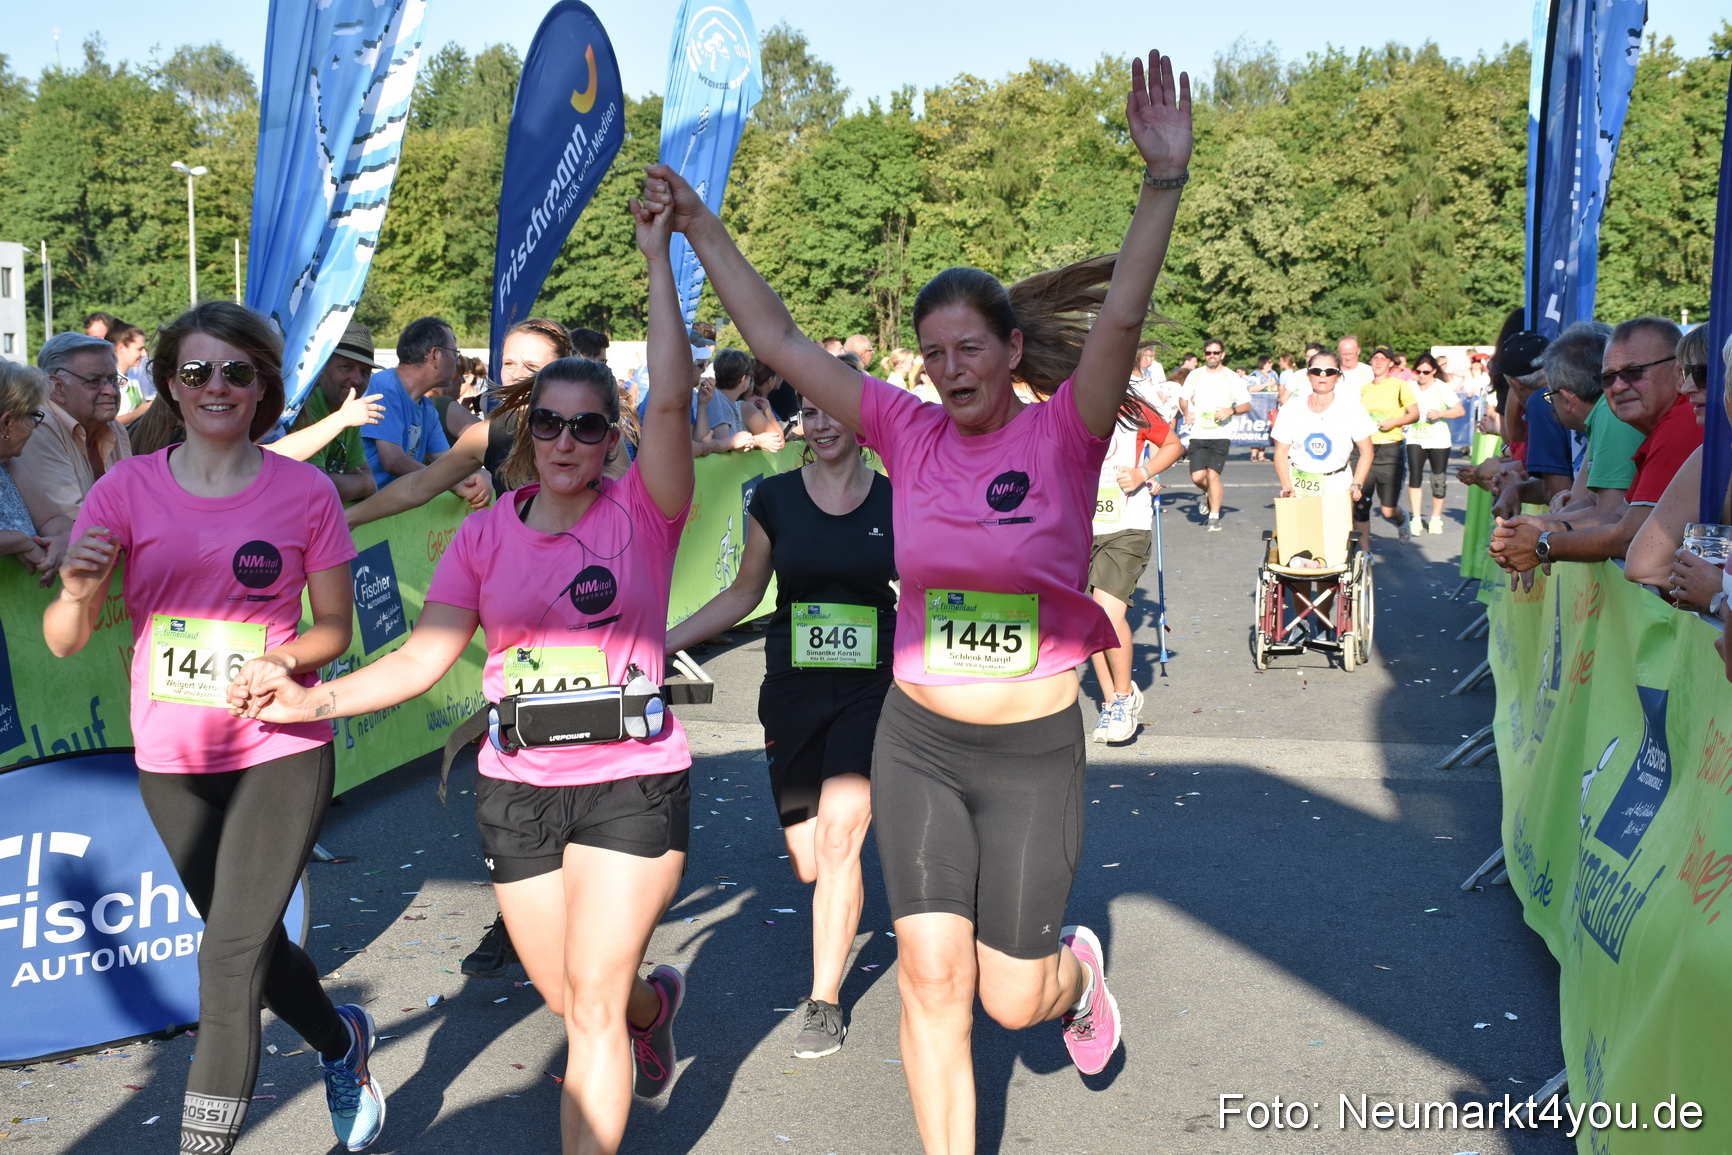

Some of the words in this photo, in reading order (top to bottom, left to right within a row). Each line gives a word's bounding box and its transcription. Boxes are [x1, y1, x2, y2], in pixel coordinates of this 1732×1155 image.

[558, 178, 580, 224] Druck
[592, 102, 617, 152] Medien
[1294, 477, 1320, 492] 2025
[1096, 500, 1114, 513] 58
[360, 575, 391, 602] Fischer
[367, 591, 392, 610] AUTOMOBILE
[940, 602, 977, 612] firmenlauf
[163, 630, 199, 640] firmenlauf
[809, 626, 857, 650] 846
[940, 620, 1022, 653] 1445
[163, 647, 245, 683] 1446
[949, 652, 982, 662] Schlenk
[984, 655, 1012, 665] Margit
[165, 678, 195, 690] Weigert
[1643, 737, 1668, 773] Fischer
[183, 1104, 228, 1123] ROSSI
